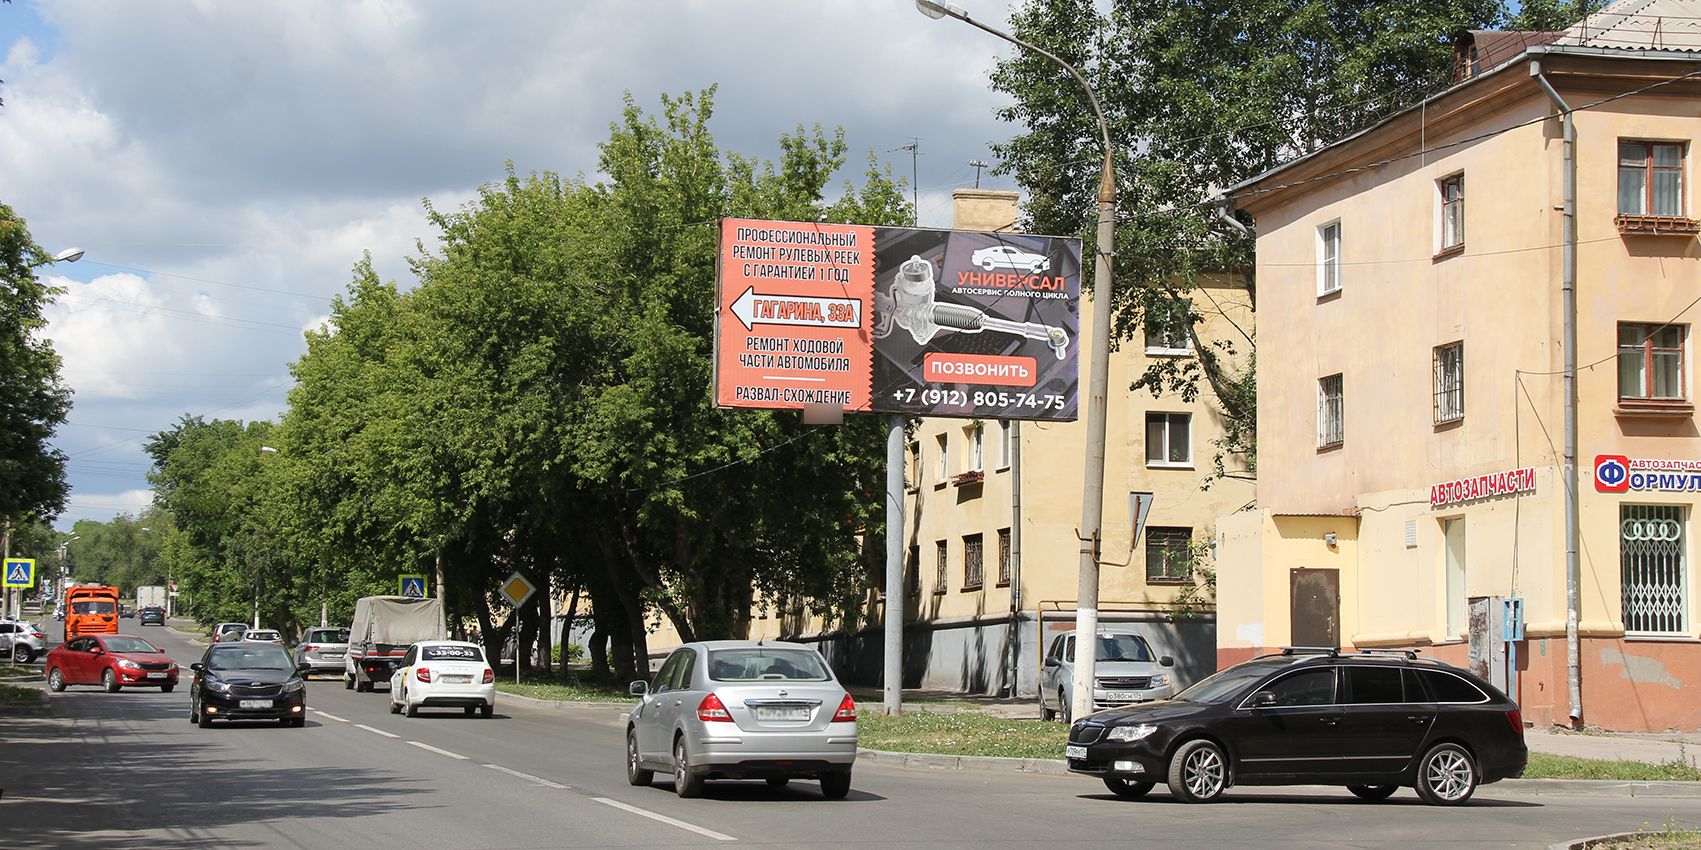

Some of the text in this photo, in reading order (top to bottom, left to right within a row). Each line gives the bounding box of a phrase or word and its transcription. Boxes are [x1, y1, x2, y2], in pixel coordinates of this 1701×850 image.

[737, 228, 856, 247] ПРОФЕССИОНАЛЬНЫЙ
[733, 246, 860, 265] РЕМОНТ РУЛЕВЫХ РЕЕК
[743, 263, 849, 283] С ГАРАНТИЕЙ 1 ГОД
[957, 271, 1065, 291] УНИВЕРСАЛ
[951, 287, 1002, 296] АВТОСЕРВИС
[1042, 291, 1069, 300] ЦИКЛА
[753, 300, 855, 323] ГАГАРИНА, 33А
[746, 337, 843, 354] РЕМОНТ ХОДОВОЙ
[739, 354, 850, 371] ЧАСТИ АВТОМОБИЛЯ
[931, 361, 1029, 378] ПОЗВОНИТЬ
[736, 386, 851, 404] РАЗВАЛ-СХОЖДЕНИЕ
[893, 388, 1065, 410] +7 (912) 805-74-75
[1430, 467, 1535, 505] АВТОЗАПЧАСТИ
